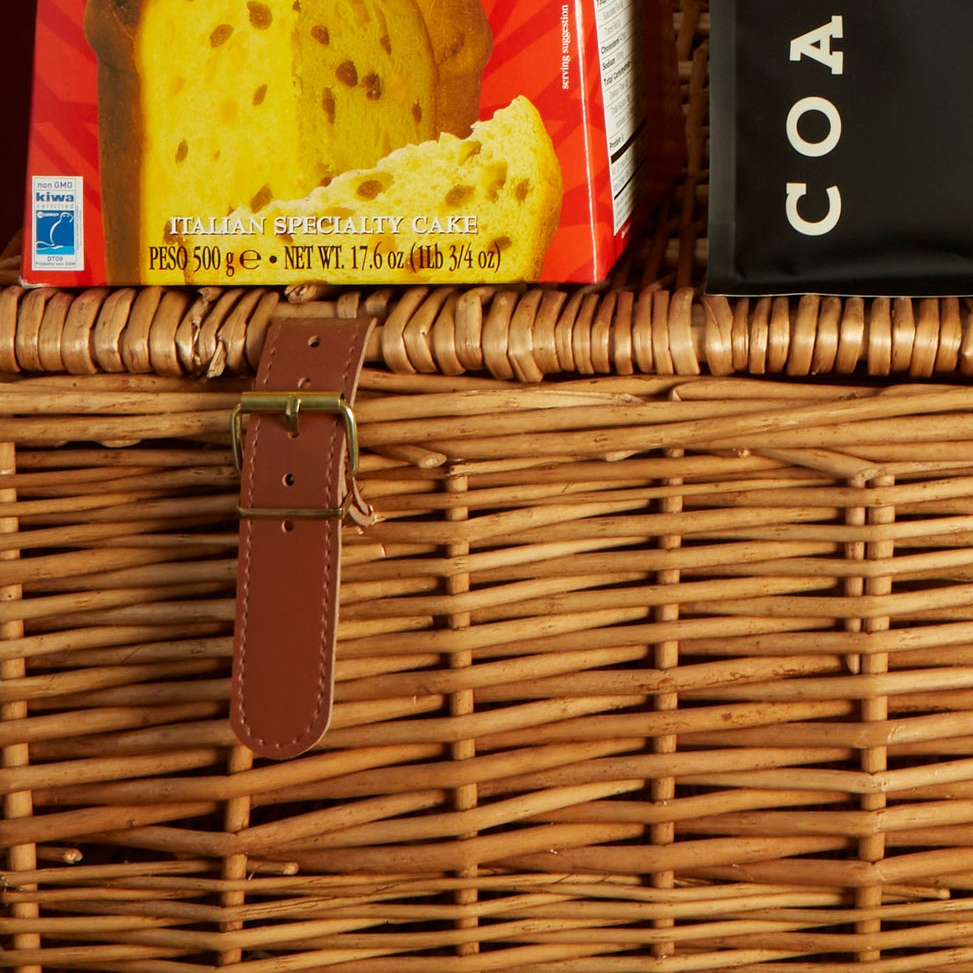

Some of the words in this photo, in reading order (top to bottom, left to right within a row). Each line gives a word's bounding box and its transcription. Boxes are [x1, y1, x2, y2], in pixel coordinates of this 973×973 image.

[560, 4, 571, 54] suggestion
[560, 54, 571, 90] serving
[36, 192, 75, 202] kiwa
[54, 181, 73, 189] GMO
[169, 216, 266, 236] ITALIAN
[273, 215, 402, 236] SPECIALTY
[411, 215, 479, 235] CAKE
[148, 245, 188, 271] PESO
[193, 245, 221, 272] 500
[226, 251, 235, 277] g
[284, 245, 314, 271] NET
[318, 245, 344, 271] WT.
[351, 242, 383, 270] 17.6
[387, 250, 405, 270] oz
[410, 242, 443, 273] (1Lb
[449, 243, 473, 271] 3/4
[478, 242, 502, 271] oz)
